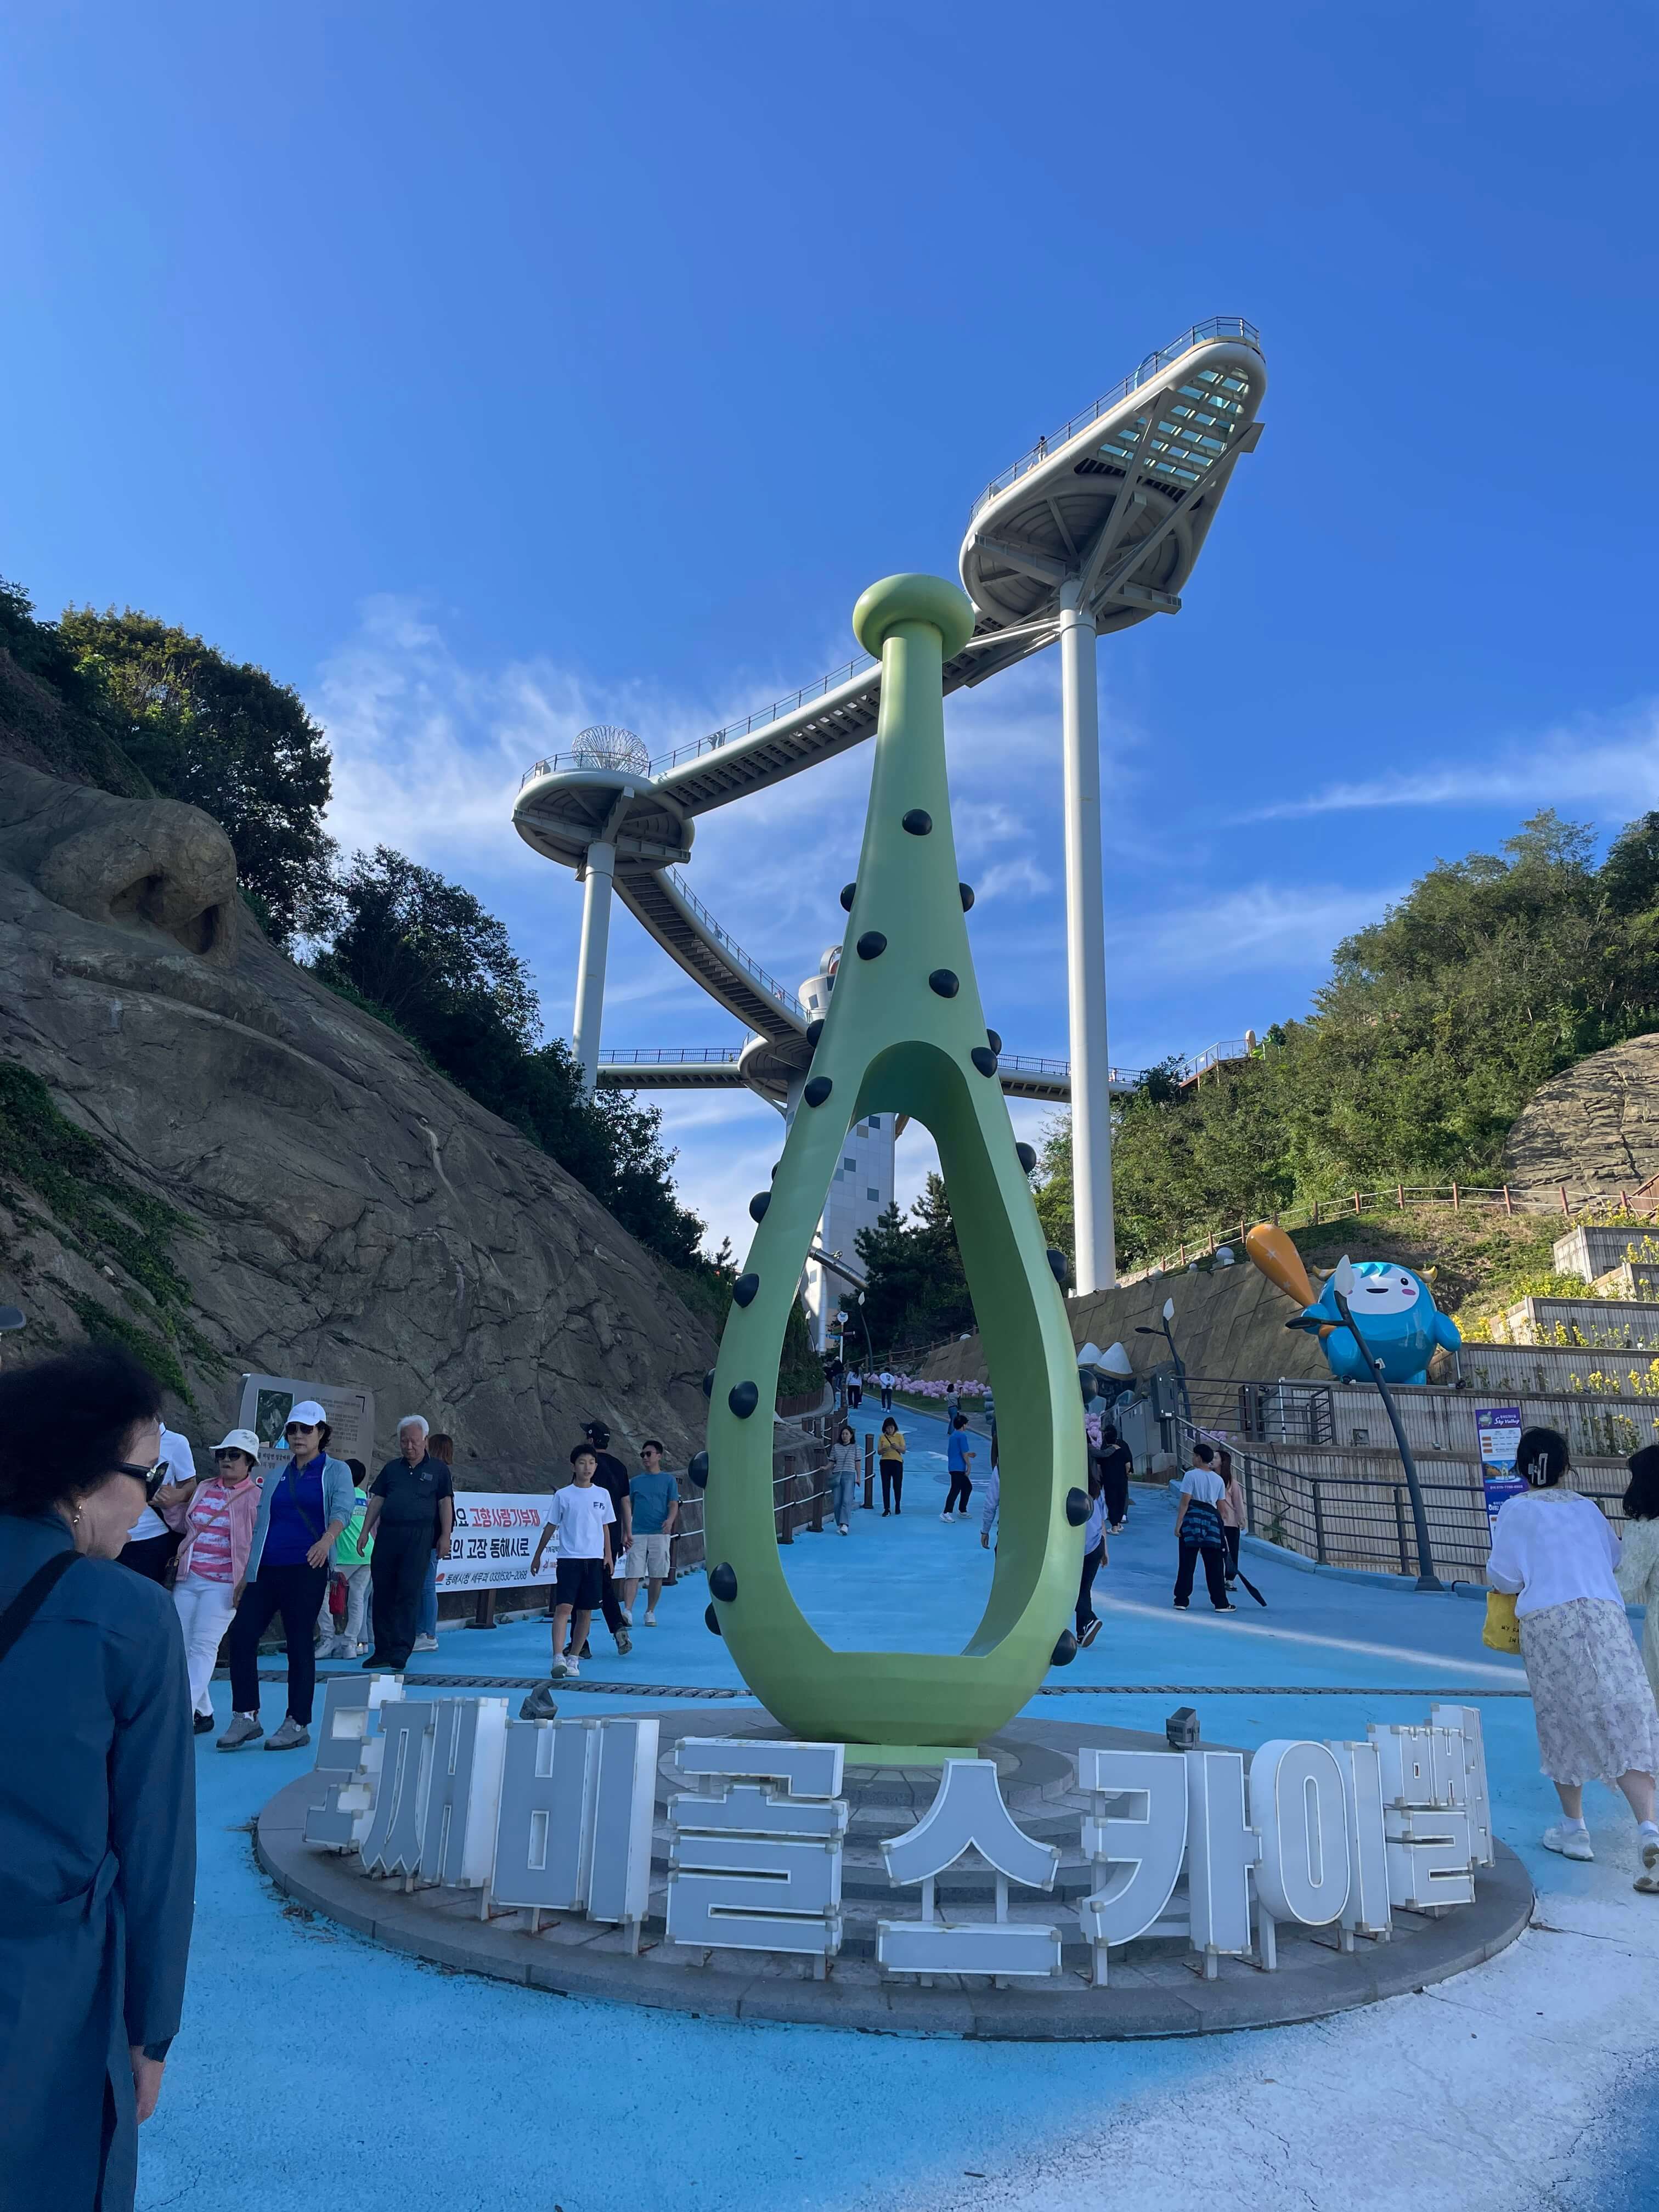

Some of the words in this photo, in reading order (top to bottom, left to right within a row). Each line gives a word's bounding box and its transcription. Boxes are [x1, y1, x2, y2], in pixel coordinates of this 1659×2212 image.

[455, 1508, 469, 1527] 요
[470, 1508, 540, 1527] 고향사랑기부제
[467, 1538, 487, 1559] 고장
[490, 1538, 530, 1558] 동해시로
[445, 1572, 470, 1585] 동해시청
[471, 1571, 489, 1584] 세무과
